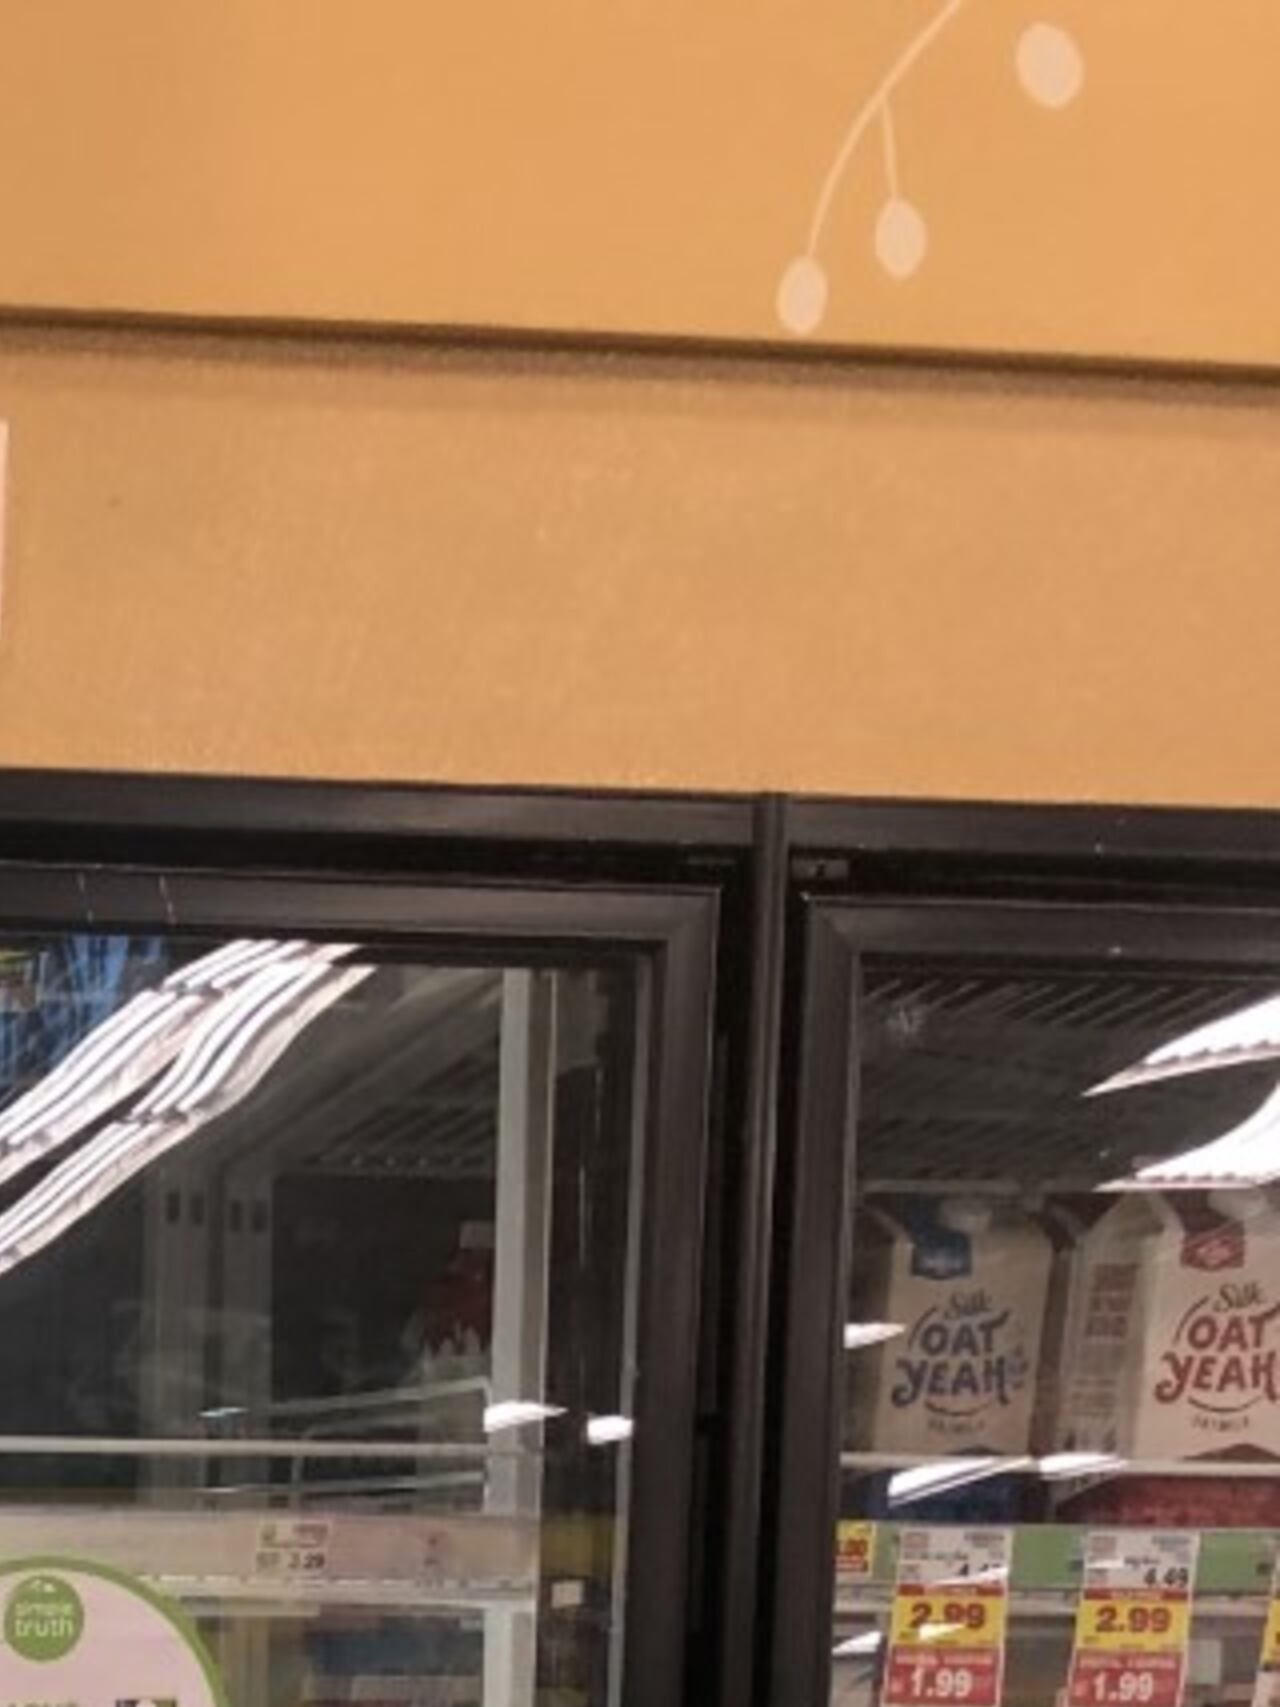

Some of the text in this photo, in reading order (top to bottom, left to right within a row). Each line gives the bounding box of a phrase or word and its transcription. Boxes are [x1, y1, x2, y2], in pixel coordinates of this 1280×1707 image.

[922, 1310, 1009, 1356] OAT
[1186, 1306, 1280, 1356] OAT
[892, 1354, 1008, 1405] YEAH
[1154, 1350, 1280, 1405] YEAH
[15, 1615, 74, 1637] truth
[911, 1602, 986, 1630] 2.99
[1095, 1606, 1171, 1633] 2.99
[911, 1667, 973, 1697] 1.99
[1094, 1671, 1154, 1701] 1.99
